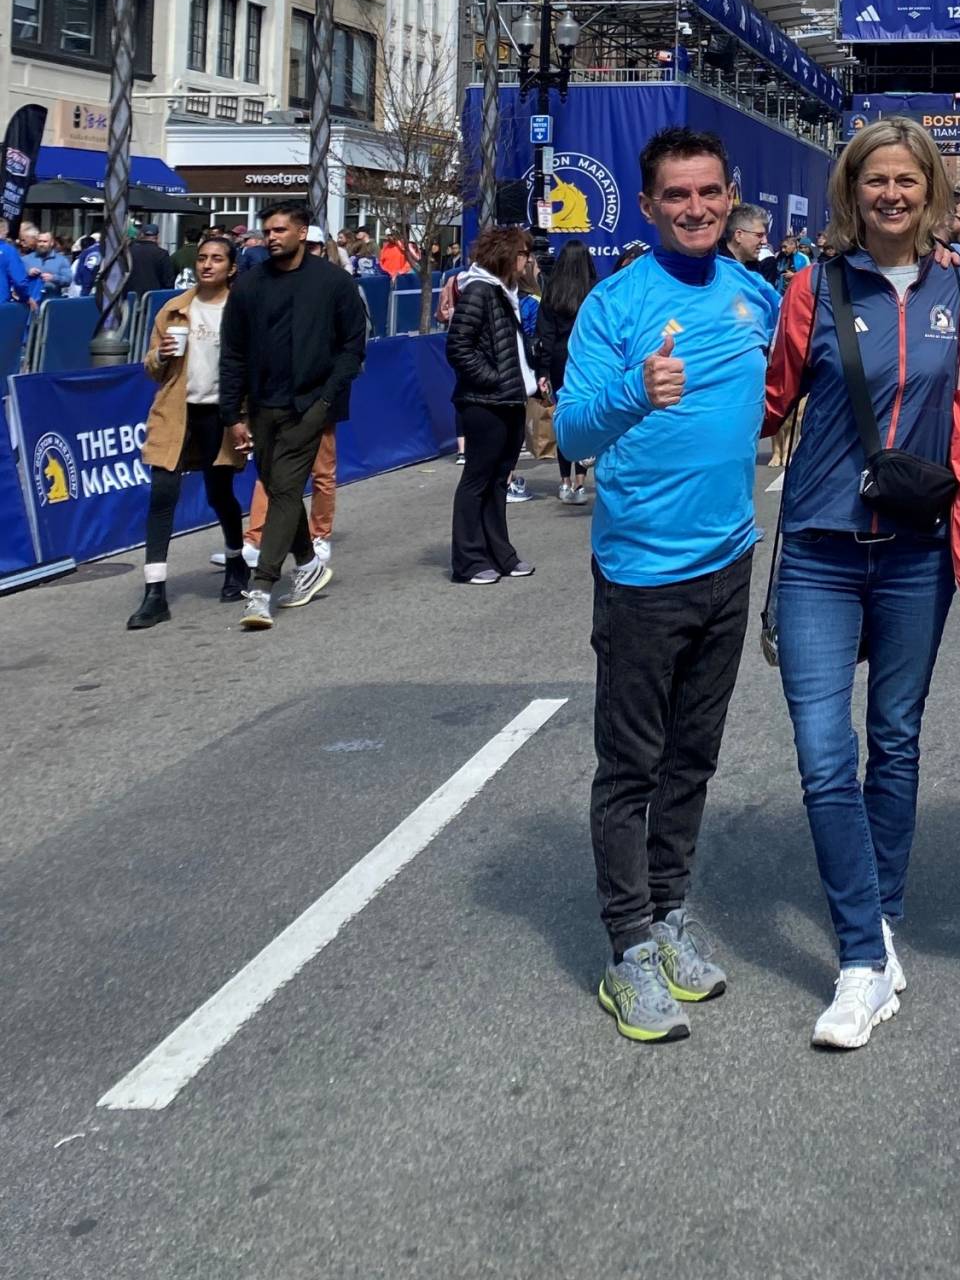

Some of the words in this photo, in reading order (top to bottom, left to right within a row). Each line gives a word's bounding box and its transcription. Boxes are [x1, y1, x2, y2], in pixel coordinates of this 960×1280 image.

[588, 246, 620, 256] RICA
[77, 428, 118, 461] THE
[81, 458, 151, 498] MARA
